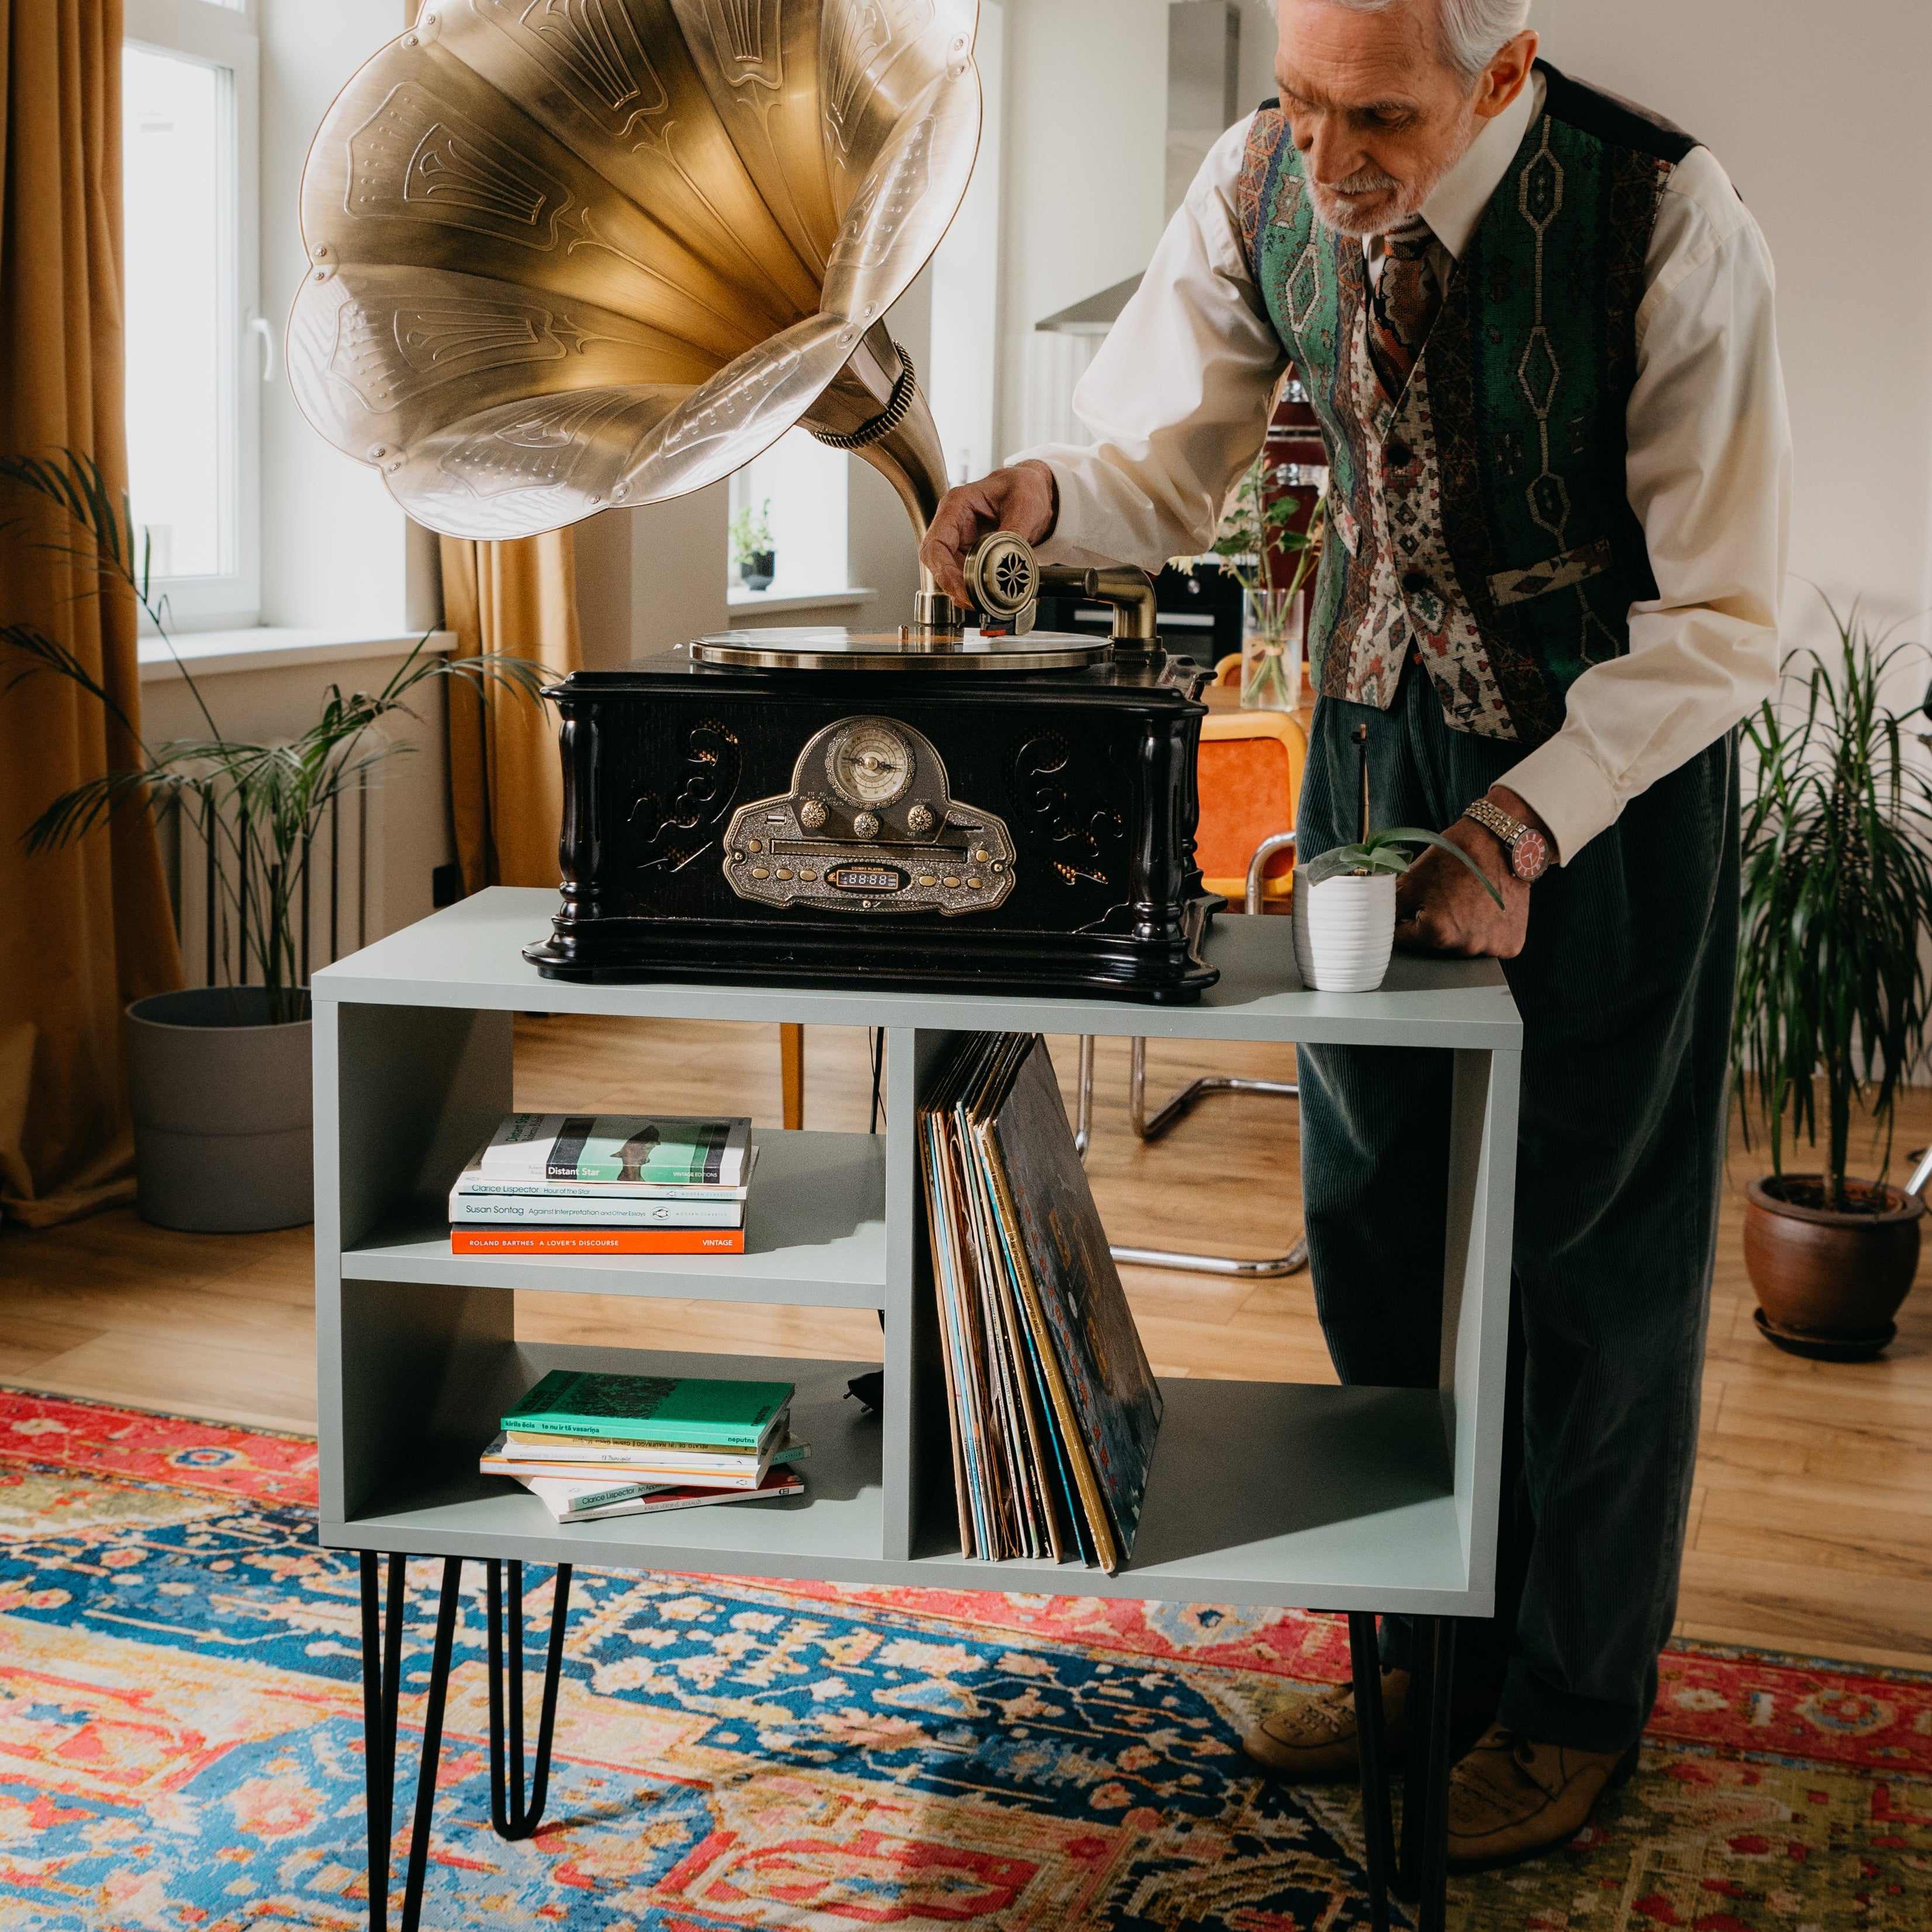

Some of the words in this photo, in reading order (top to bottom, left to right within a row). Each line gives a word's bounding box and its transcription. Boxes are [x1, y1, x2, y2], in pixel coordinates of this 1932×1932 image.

[548, 1167, 579, 1176] Distant
[582, 1168, 600, 1176] Star
[472, 1184, 501, 1193] Clarice
[503, 1185, 539, 1194] Lispector
[466, 1205, 492, 1214] Susan
[493, 1206, 524, 1215] Sontag
[1012, 1249, 1025, 1281] FOGELBERG
[1024, 1291, 1036, 1319] CAPTURED
[582, 1493, 605, 1505] Clarice
[606, 1488, 635, 1500] Lispector
